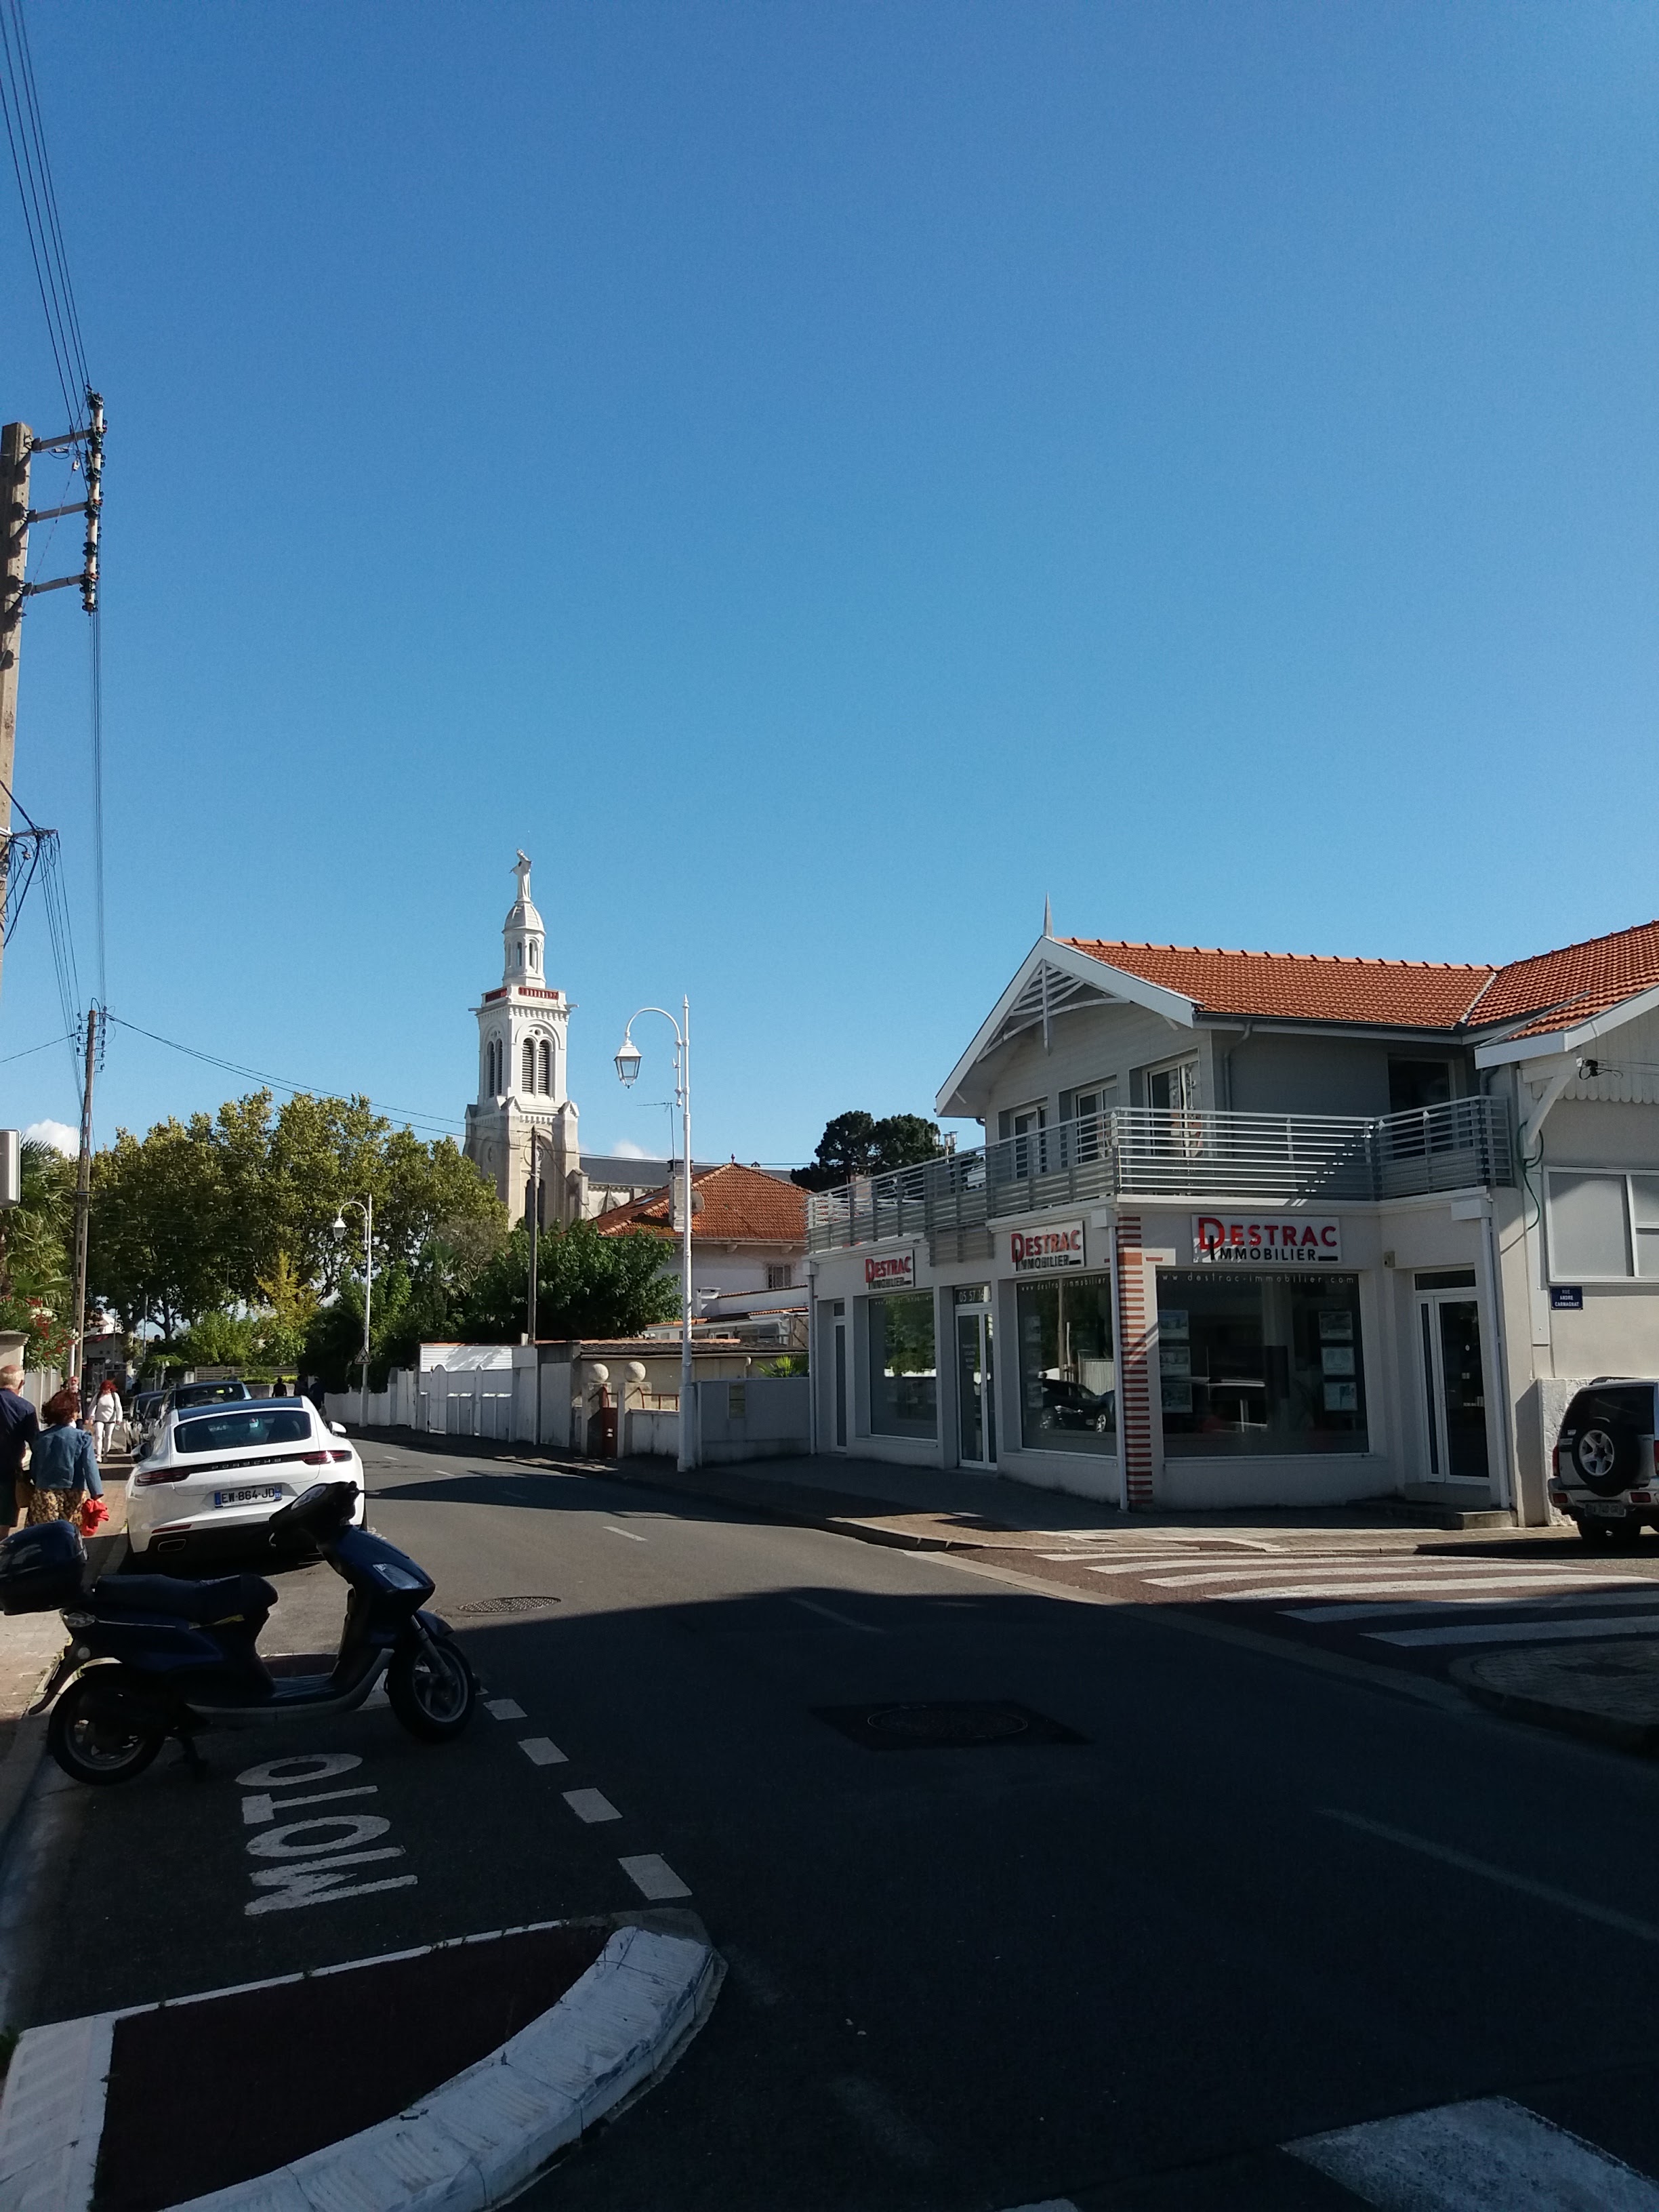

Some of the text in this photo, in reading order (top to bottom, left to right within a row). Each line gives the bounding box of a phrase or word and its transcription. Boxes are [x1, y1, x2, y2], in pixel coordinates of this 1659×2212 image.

[1010, 1229, 1081, 1263] DESTRAC
[1198, 1217, 1338, 1250] DESTRAC
[1015, 1251, 1069, 1271] IMMOBILIER
[1210, 1235, 1316, 1261] IMMOBILIER
[865, 1256, 912, 1283] DESTRAC
[959, 1291, 967, 1303] 05
[969, 1290, 975, 1302] 57
[211, 1458, 281, 1470] PORSCHE
[221, 1488, 275, 1504] EW-864-JD
[234, 1753, 419, 1917] MOTO
